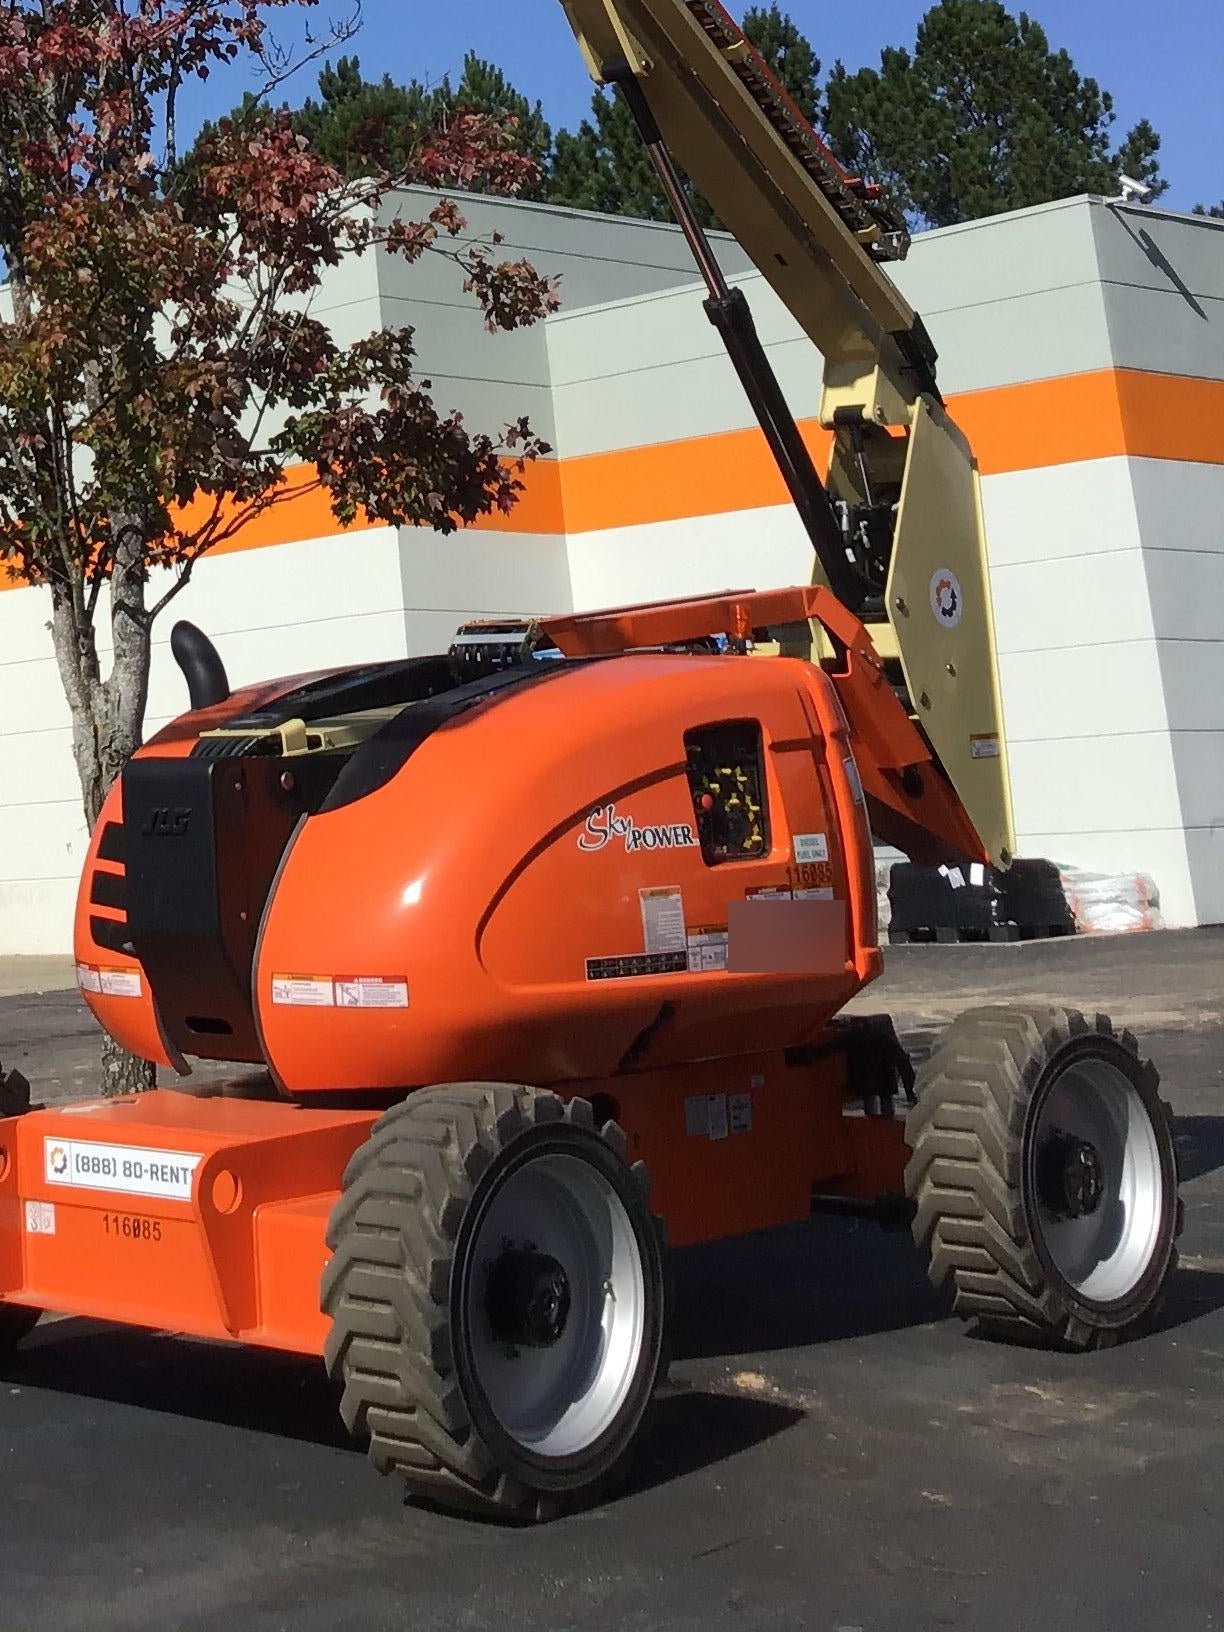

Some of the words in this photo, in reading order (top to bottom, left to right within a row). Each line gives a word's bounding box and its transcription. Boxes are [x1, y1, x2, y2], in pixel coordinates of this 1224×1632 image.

[577, 804, 633, 853] Sky
[630, 824, 694, 850] POWER
[786, 863, 834, 886] 116085
[75, 1153, 118, 1178] (888)
[122, 1159, 195, 1186] 80-RENT
[103, 1213, 162, 1242] 116085
